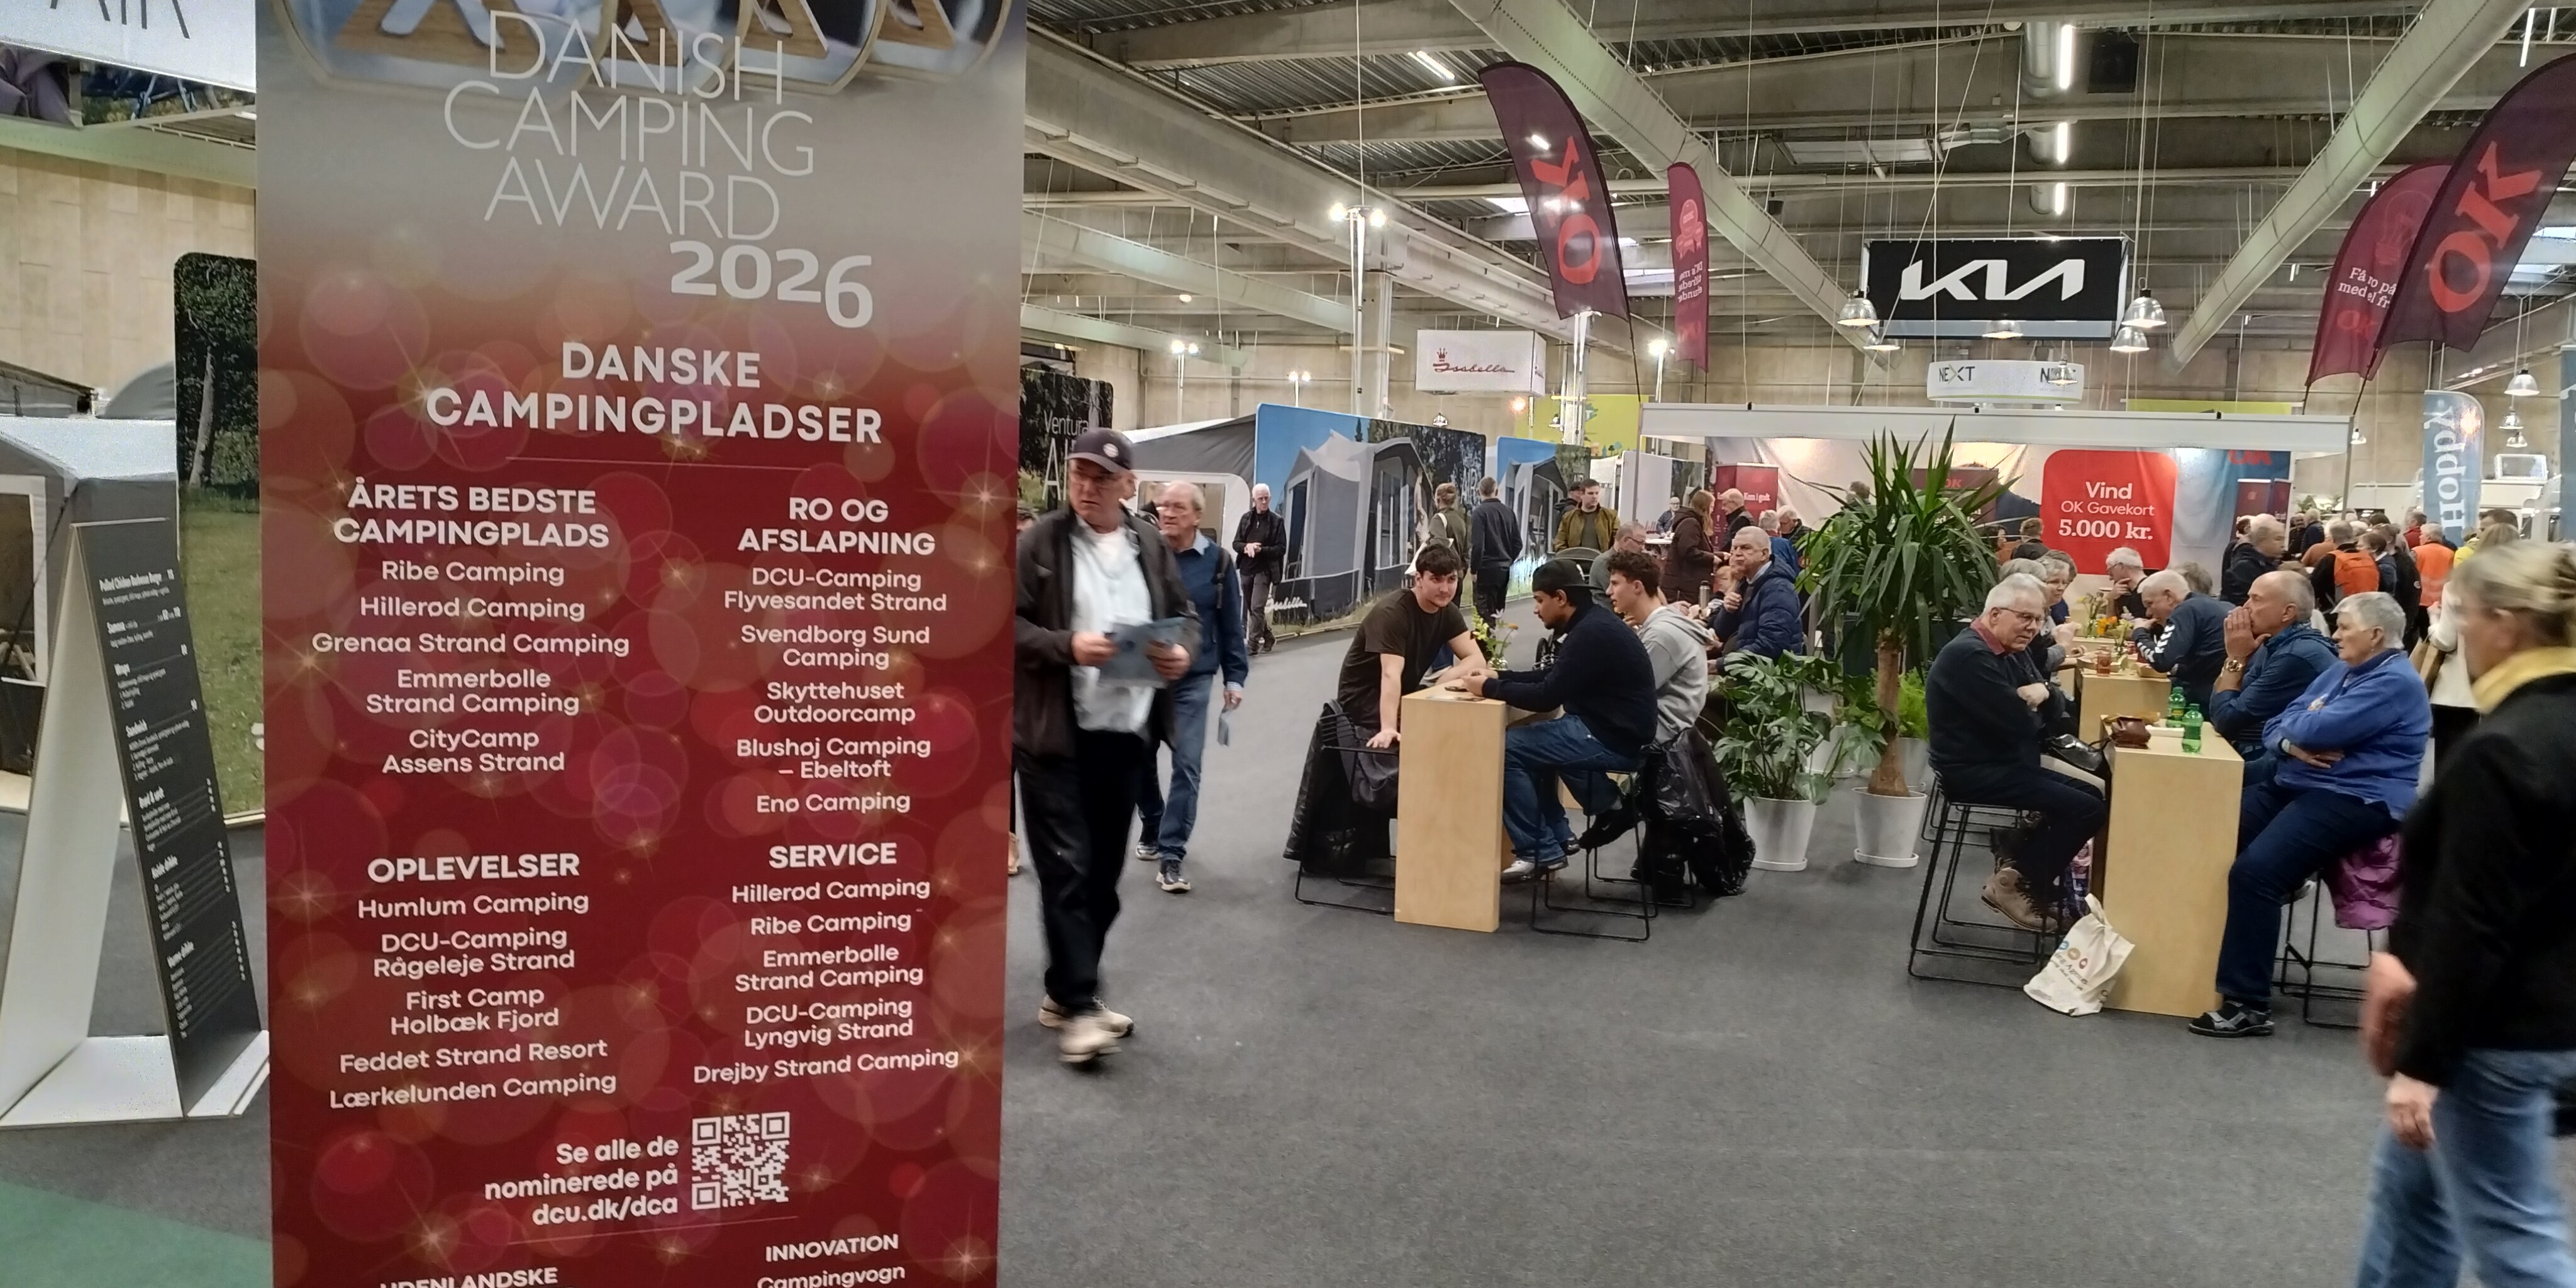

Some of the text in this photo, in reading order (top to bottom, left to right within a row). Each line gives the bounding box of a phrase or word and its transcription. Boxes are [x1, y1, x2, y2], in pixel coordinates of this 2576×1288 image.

[488, 9, 787, 105] DANISH
[443, 82, 816, 177] CAMPING
[483, 156, 782, 242] AWARD
[2429, 140, 2543, 313] OK
[670, 240, 874, 328] 2026
[2349, 267, 2366, 282] Få
[2367, 276, 2378, 288] ro
[2338, 282, 2367, 297] med
[2377, 296, 2390, 309] fr
[563, 342, 760, 387] DANSKE
[1433, 363, 1515, 373] Isabella
[1939, 366, 1975, 382] NEXT
[425, 388, 882, 444] CAMPINGPLADSER
[1044, 409, 1089, 436] Ventura
[348, 477, 596, 514] ÅRETS BEDSTE
[2085, 481, 2133, 499] Vind
[790, 497, 889, 522] RO OG
[2061, 501, 2155, 516] OK Gavekort
[333, 519, 610, 547] CAMPINGPLADS
[738, 528, 935, 555] AFSLAPNING
[2058, 519, 2153, 540] 5.000 kr.
[382, 560, 564, 586] Ribe Camping
[753, 568, 921, 592] DCU-Camping
[361, 596, 584, 622] Hillerød Camping
[725, 591, 947, 612] Flyvesandet Strand
[313, 633, 629, 657] Grenaa Strand Camping
[741, 625, 930, 648] Svendborg Sund
[784, 648, 889, 670] Camping
[398, 669, 551, 687] Emmerbølle
[366, 692, 579, 716] Strand Camping
[767, 682, 904, 702] Skyttehuset
[754, 705, 916, 725] Outdoorcamp
[409, 729, 539, 752] CityCamp
[737, 736, 930, 759] Blushøj Camping
[382, 752, 564, 773] Assens Strand
[801, 760, 891, 778] Ebeltoft
[757, 792, 910, 814] Enø Camping
[368, 853, 579, 882] OPLEVELSER
[769, 843, 897, 869] SERVICE
[733, 879, 930, 903] Hillerød Camping
[358, 892, 589, 918] Humlum Camping
[752, 911, 911, 935] Ribe Camping
[382, 927, 567, 952] DCU-Camping
[374, 949, 575, 979] Rågeleje Strand
[763, 944, 899, 968] Emmerbølle
[735, 965, 923, 992] Strand Camping
[407, 989, 544, 1011] First Camp
[747, 998, 912, 1024] DCU-Camping
[391, 1008, 558, 1035] Holbæk Fjord
[745, 1019, 913, 1050] Lyngvig Strand
[341, 1040, 608, 1073] Feddet Strand Resort
[694, 1048, 958, 1084] Drejby Strand Camping
[330, 1073, 616, 1108] Lærkelunden Camping
[557, 1136, 679, 1164] Se alle de
[485, 1163, 678, 1200] nominerede på
[532, 1196, 677, 1225] dcu.dk/dca
[766, 1234, 898, 1262] INNOVATION
[757, 1266, 906, 1288] Campingvogn
